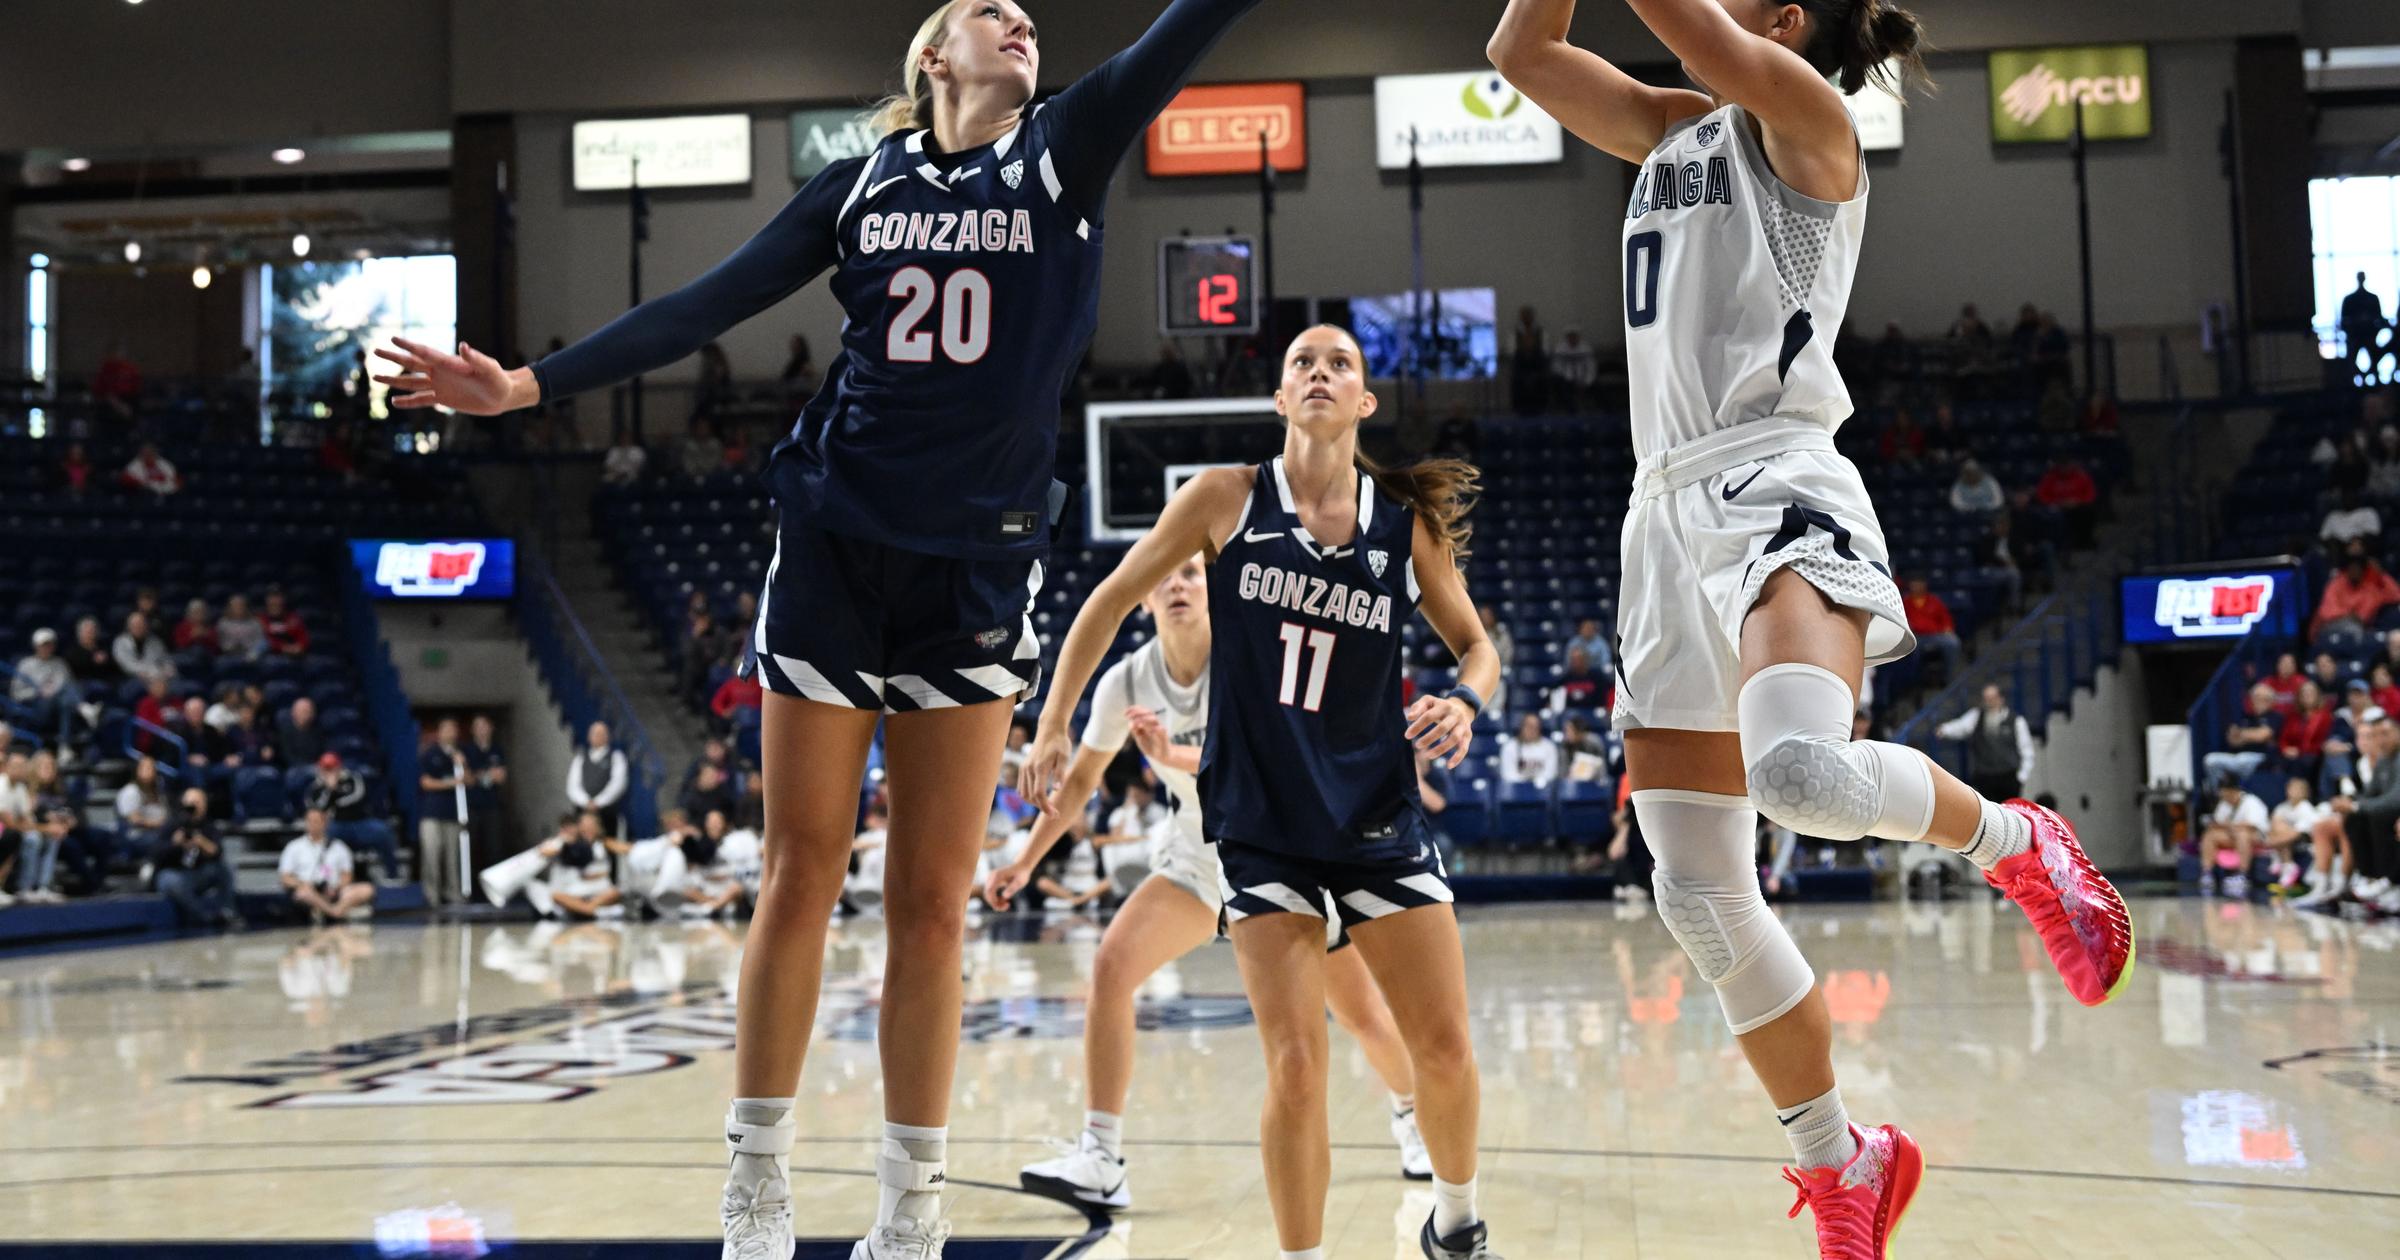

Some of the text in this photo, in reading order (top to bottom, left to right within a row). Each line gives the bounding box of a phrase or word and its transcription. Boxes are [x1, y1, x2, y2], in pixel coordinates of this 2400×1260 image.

[1171, 113, 1280, 142] BECU
[1396, 124, 1540, 147] NUMERICA
[860, 208, 1035, 254] GONZAGA
[887, 264, 992, 364] 20
[1199, 274, 1237, 324] 12
[1238, 562, 1392, 634] GONZAGA
[1278, 620, 1336, 712] 11
